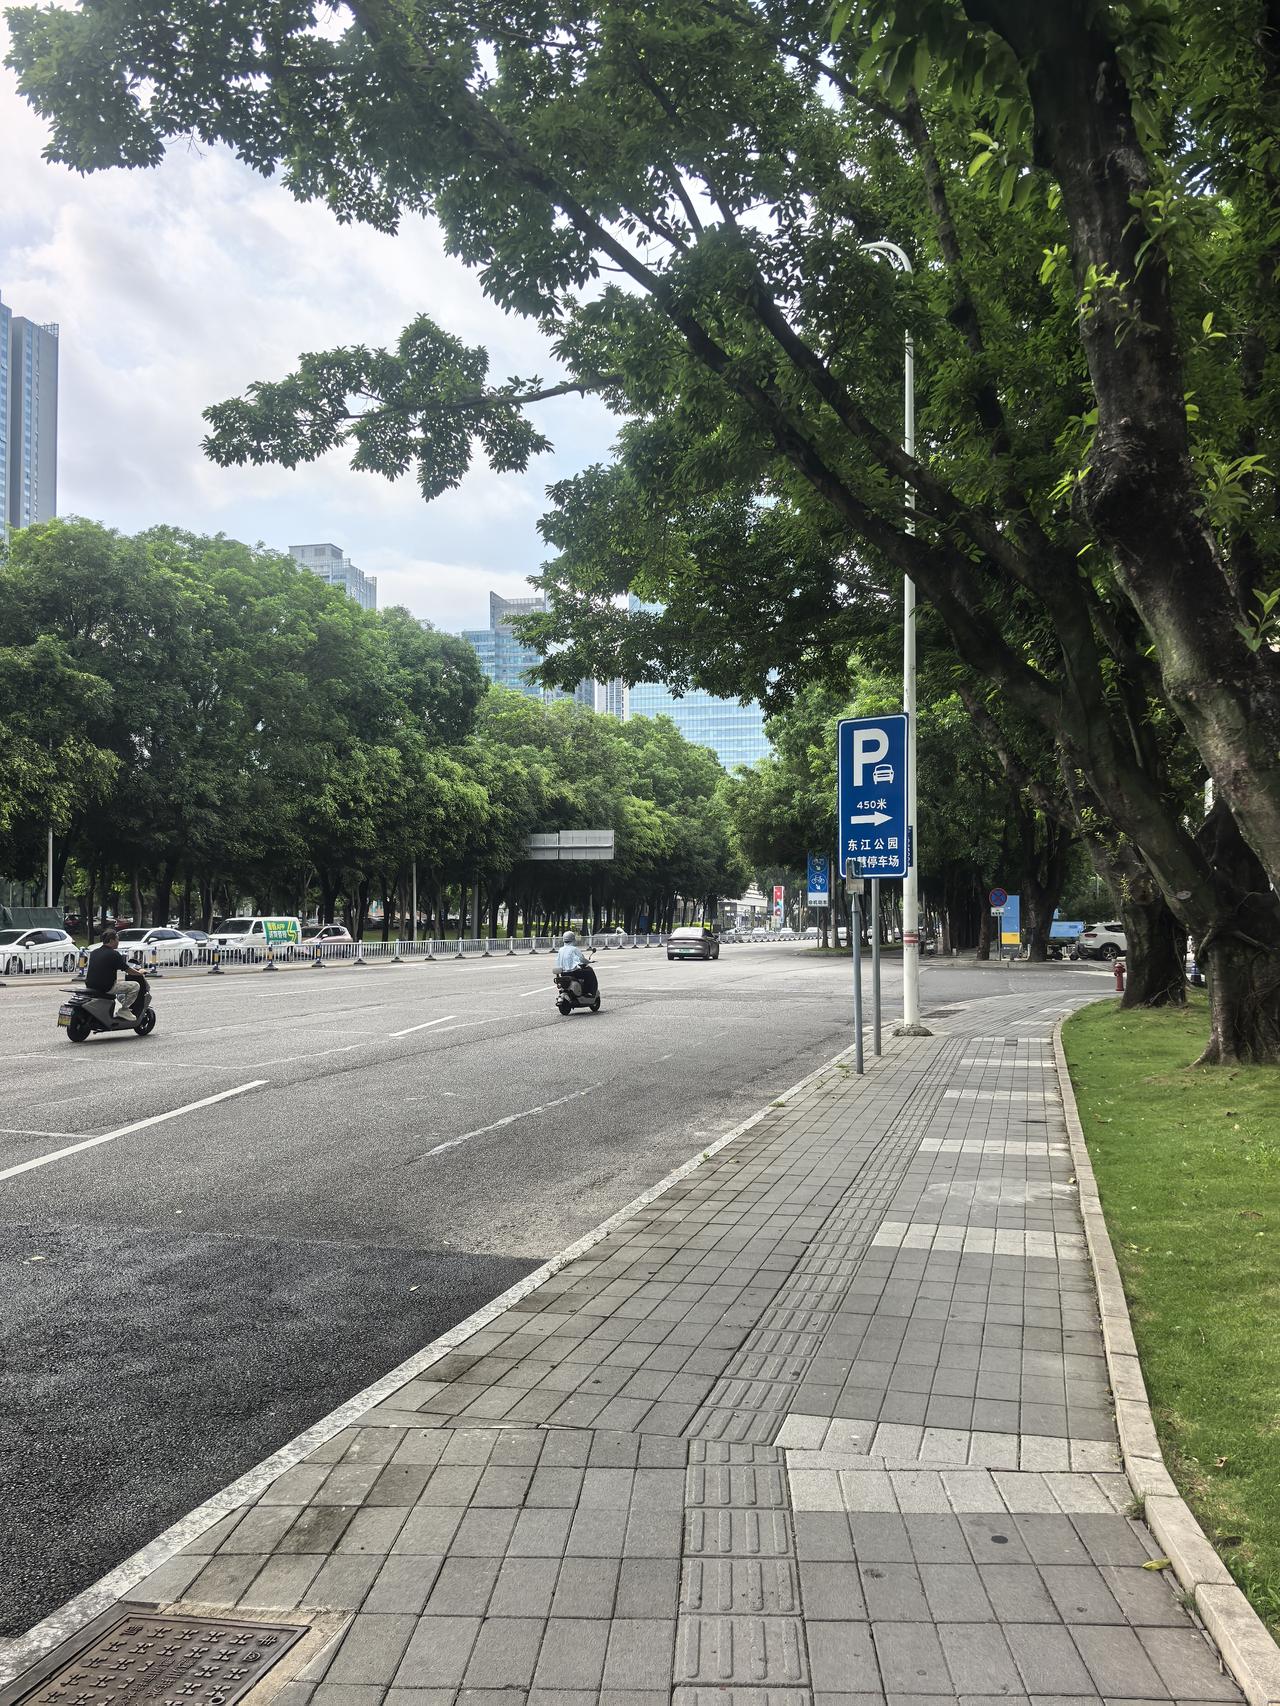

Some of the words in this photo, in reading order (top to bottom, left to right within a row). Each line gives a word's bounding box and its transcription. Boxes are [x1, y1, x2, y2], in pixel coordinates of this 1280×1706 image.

[853, 728, 889, 787] P
[856, 798, 887, 810] 450米
[847, 837, 898, 852] 东江公园
[846, 855, 899, 868] 慧停车场
